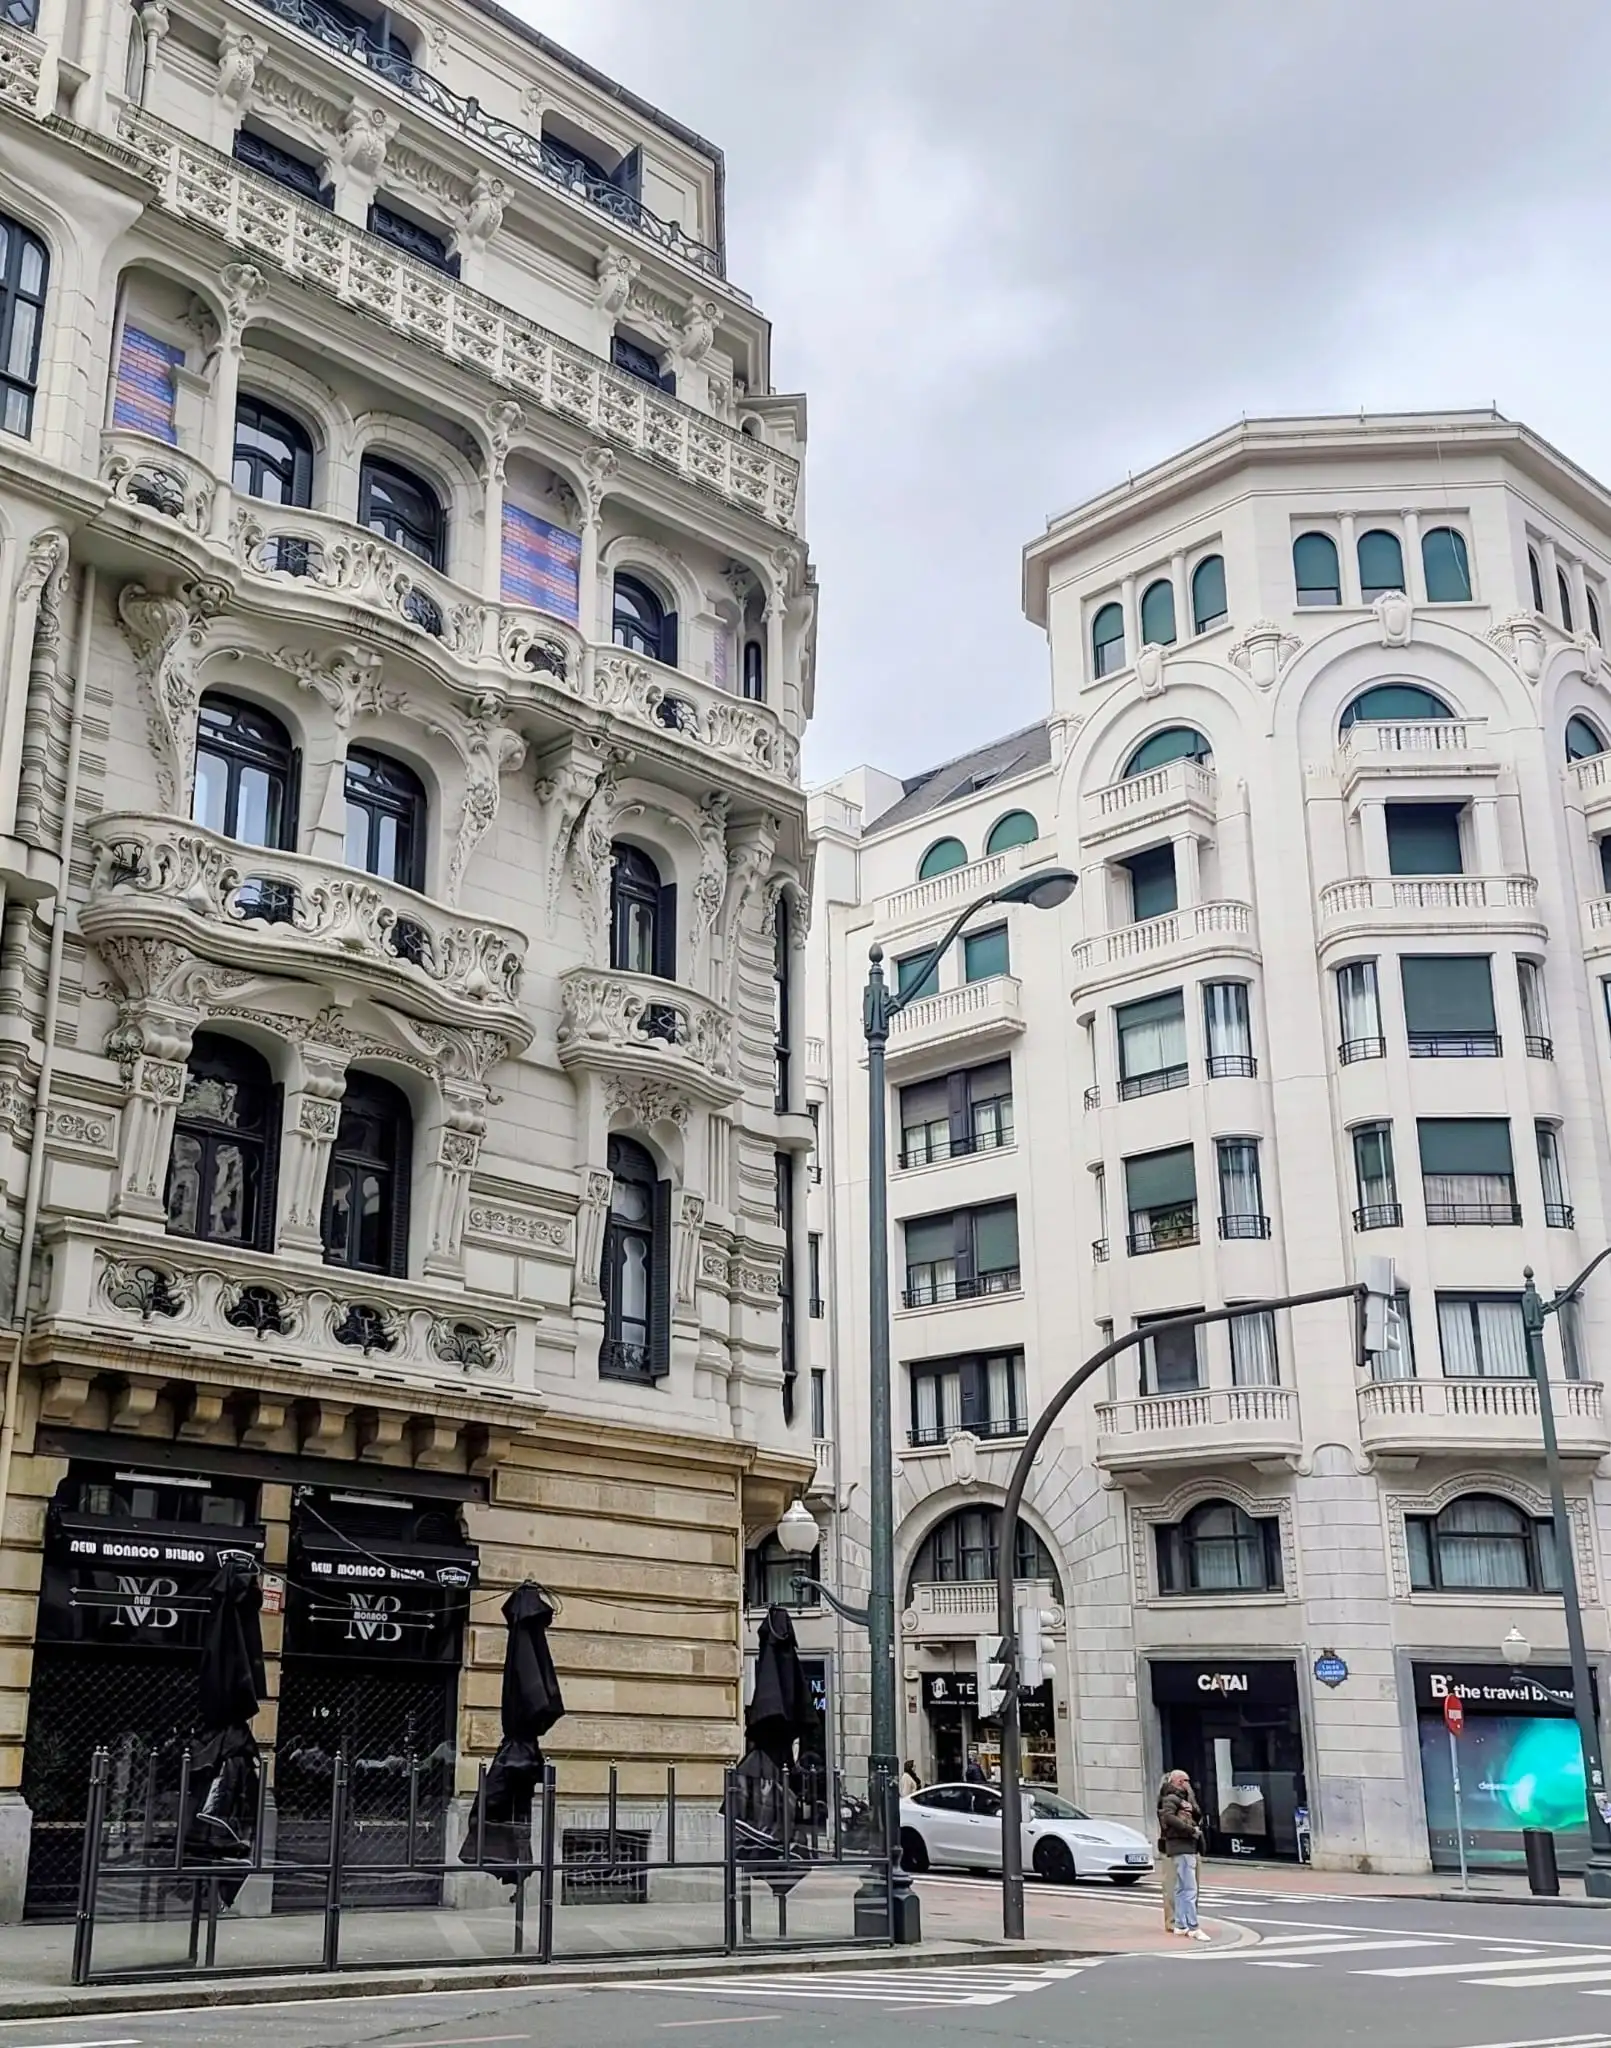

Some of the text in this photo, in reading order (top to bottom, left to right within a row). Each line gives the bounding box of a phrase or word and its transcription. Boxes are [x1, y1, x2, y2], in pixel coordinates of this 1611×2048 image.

[70, 1540, 97, 1554] NEW
[103, 1543, 159, 1559] MONACO
[165, 1548, 205, 1563] BILBAO
[311, 1561, 332, 1574] NEW
[337, 1563, 386, 1578] MONACO
[133, 1595, 151, 1605] NEW
[353, 1612, 388, 1621] MONACO
[1197, 1674, 1248, 1691] CATAI
[1453, 1683, 1481, 1699] the
[1483, 1685, 1529, 1700] travel
